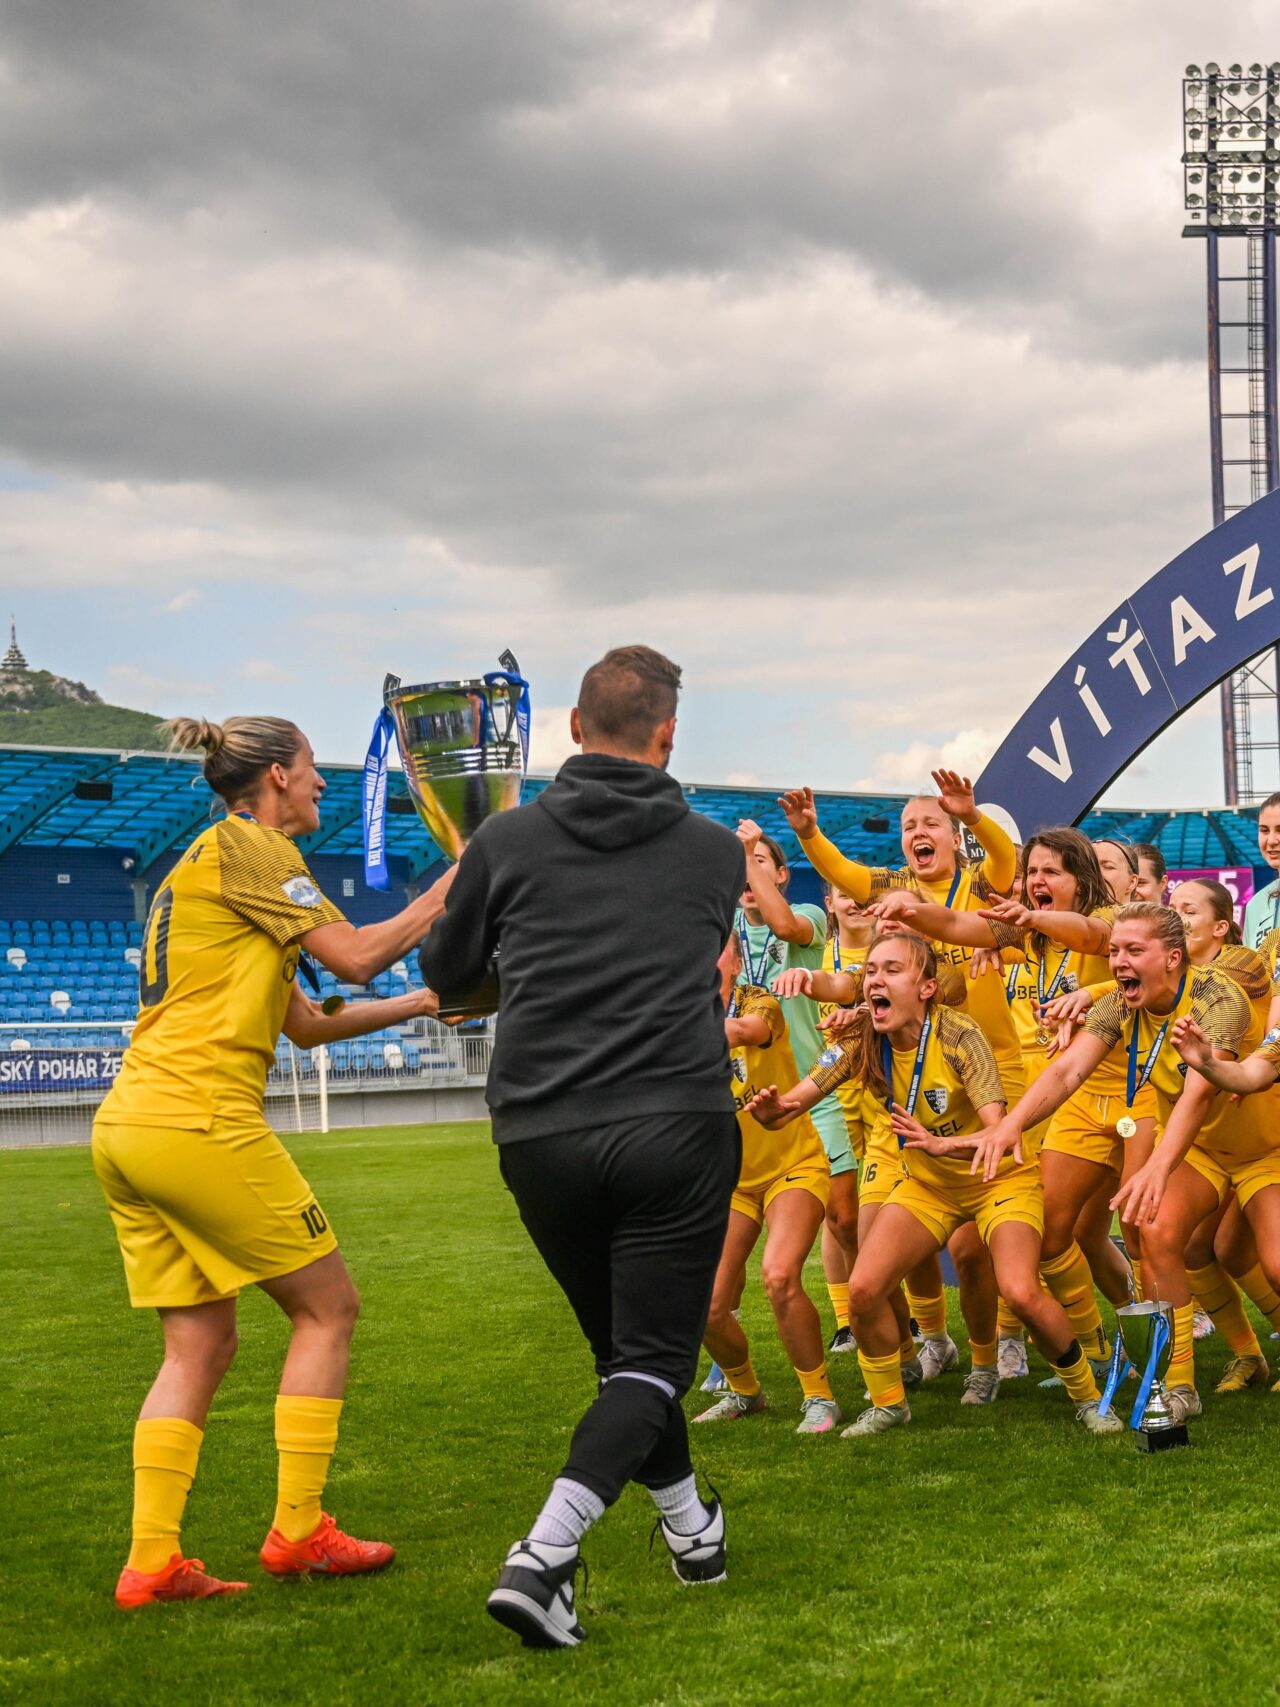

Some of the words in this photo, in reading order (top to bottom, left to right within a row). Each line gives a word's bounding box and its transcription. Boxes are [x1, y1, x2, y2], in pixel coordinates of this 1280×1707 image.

[1026, 543, 1275, 784] VÍŤAZ
[0, 1054, 34, 1081] SKÝ
[38, 1053, 99, 1080] POHÁR
[101, 1051, 122, 1078] ŽE
[301, 1204, 327, 1239] 10
